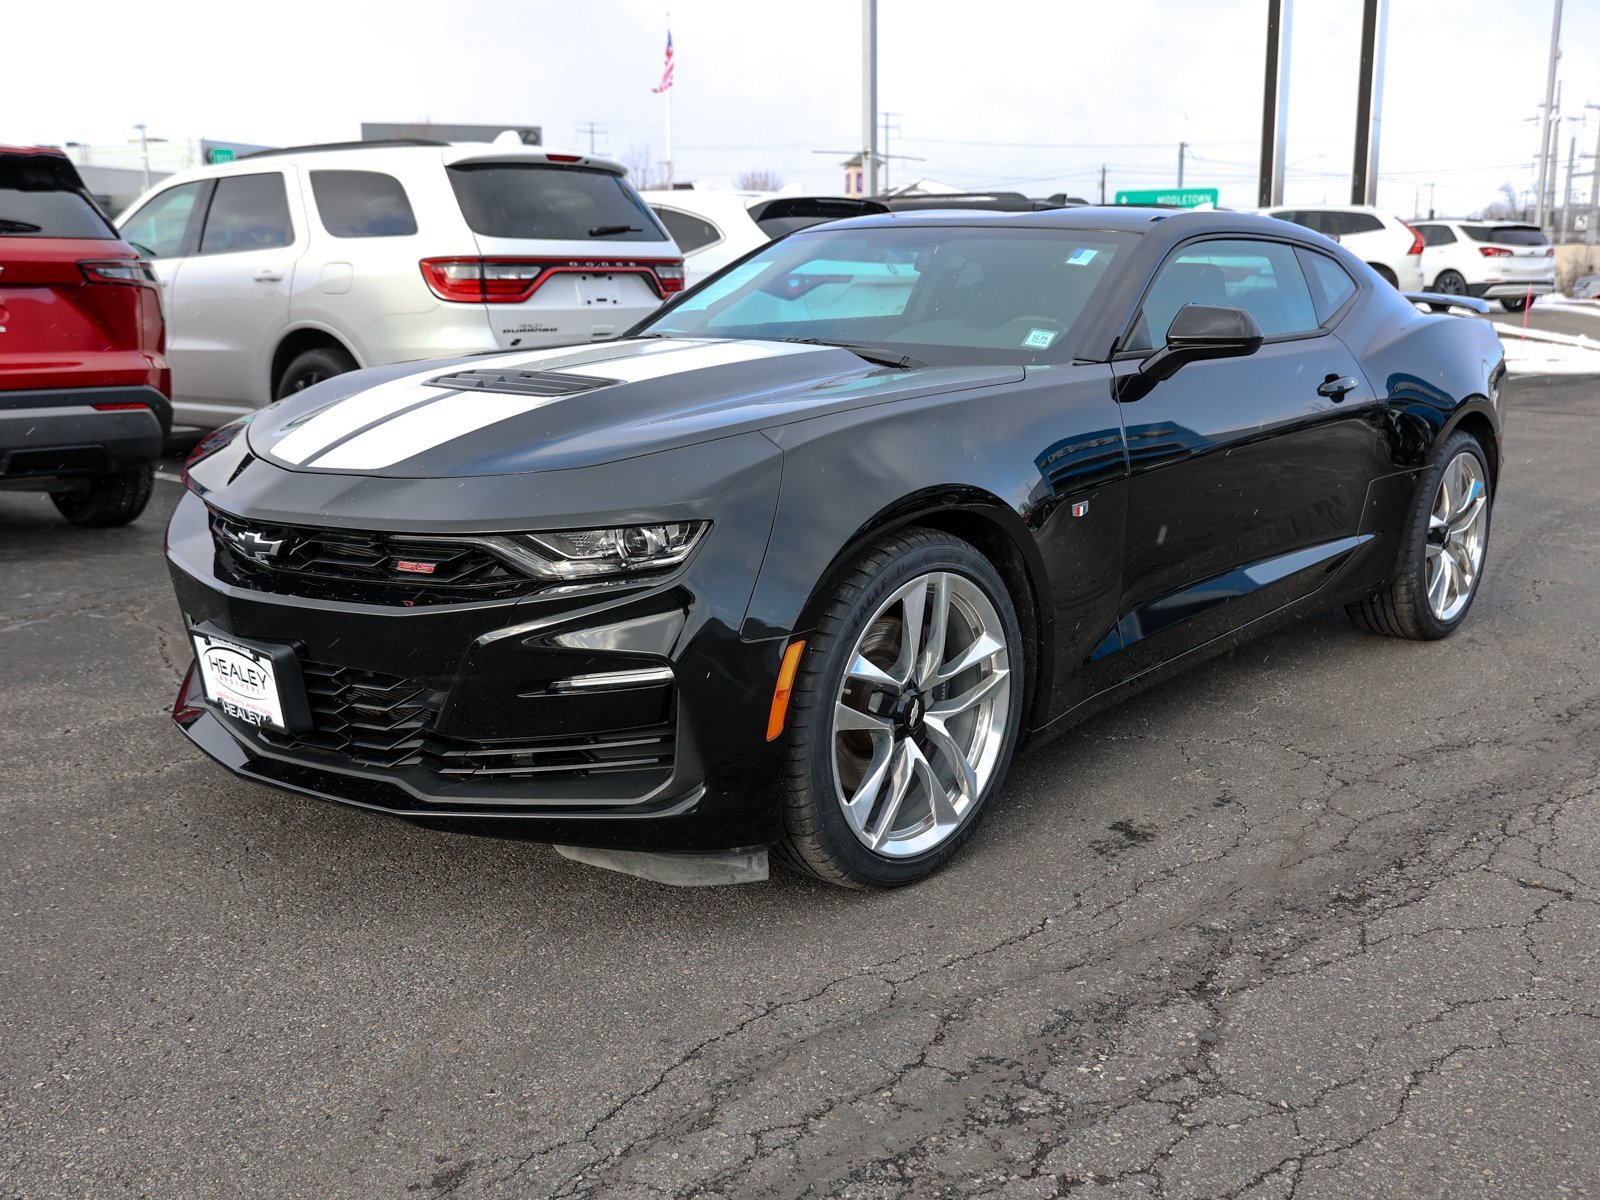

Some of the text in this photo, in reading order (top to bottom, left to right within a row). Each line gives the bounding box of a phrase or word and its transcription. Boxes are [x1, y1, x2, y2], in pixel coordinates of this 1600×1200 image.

[1157, 194, 1211, 205] MIDDLETOWN
[396, 560, 436, 574] SS
[208, 654, 267, 690] HEALEY
[219, 675, 260, 694] BROTHERS
[222, 701, 263, 726] HEALEY
